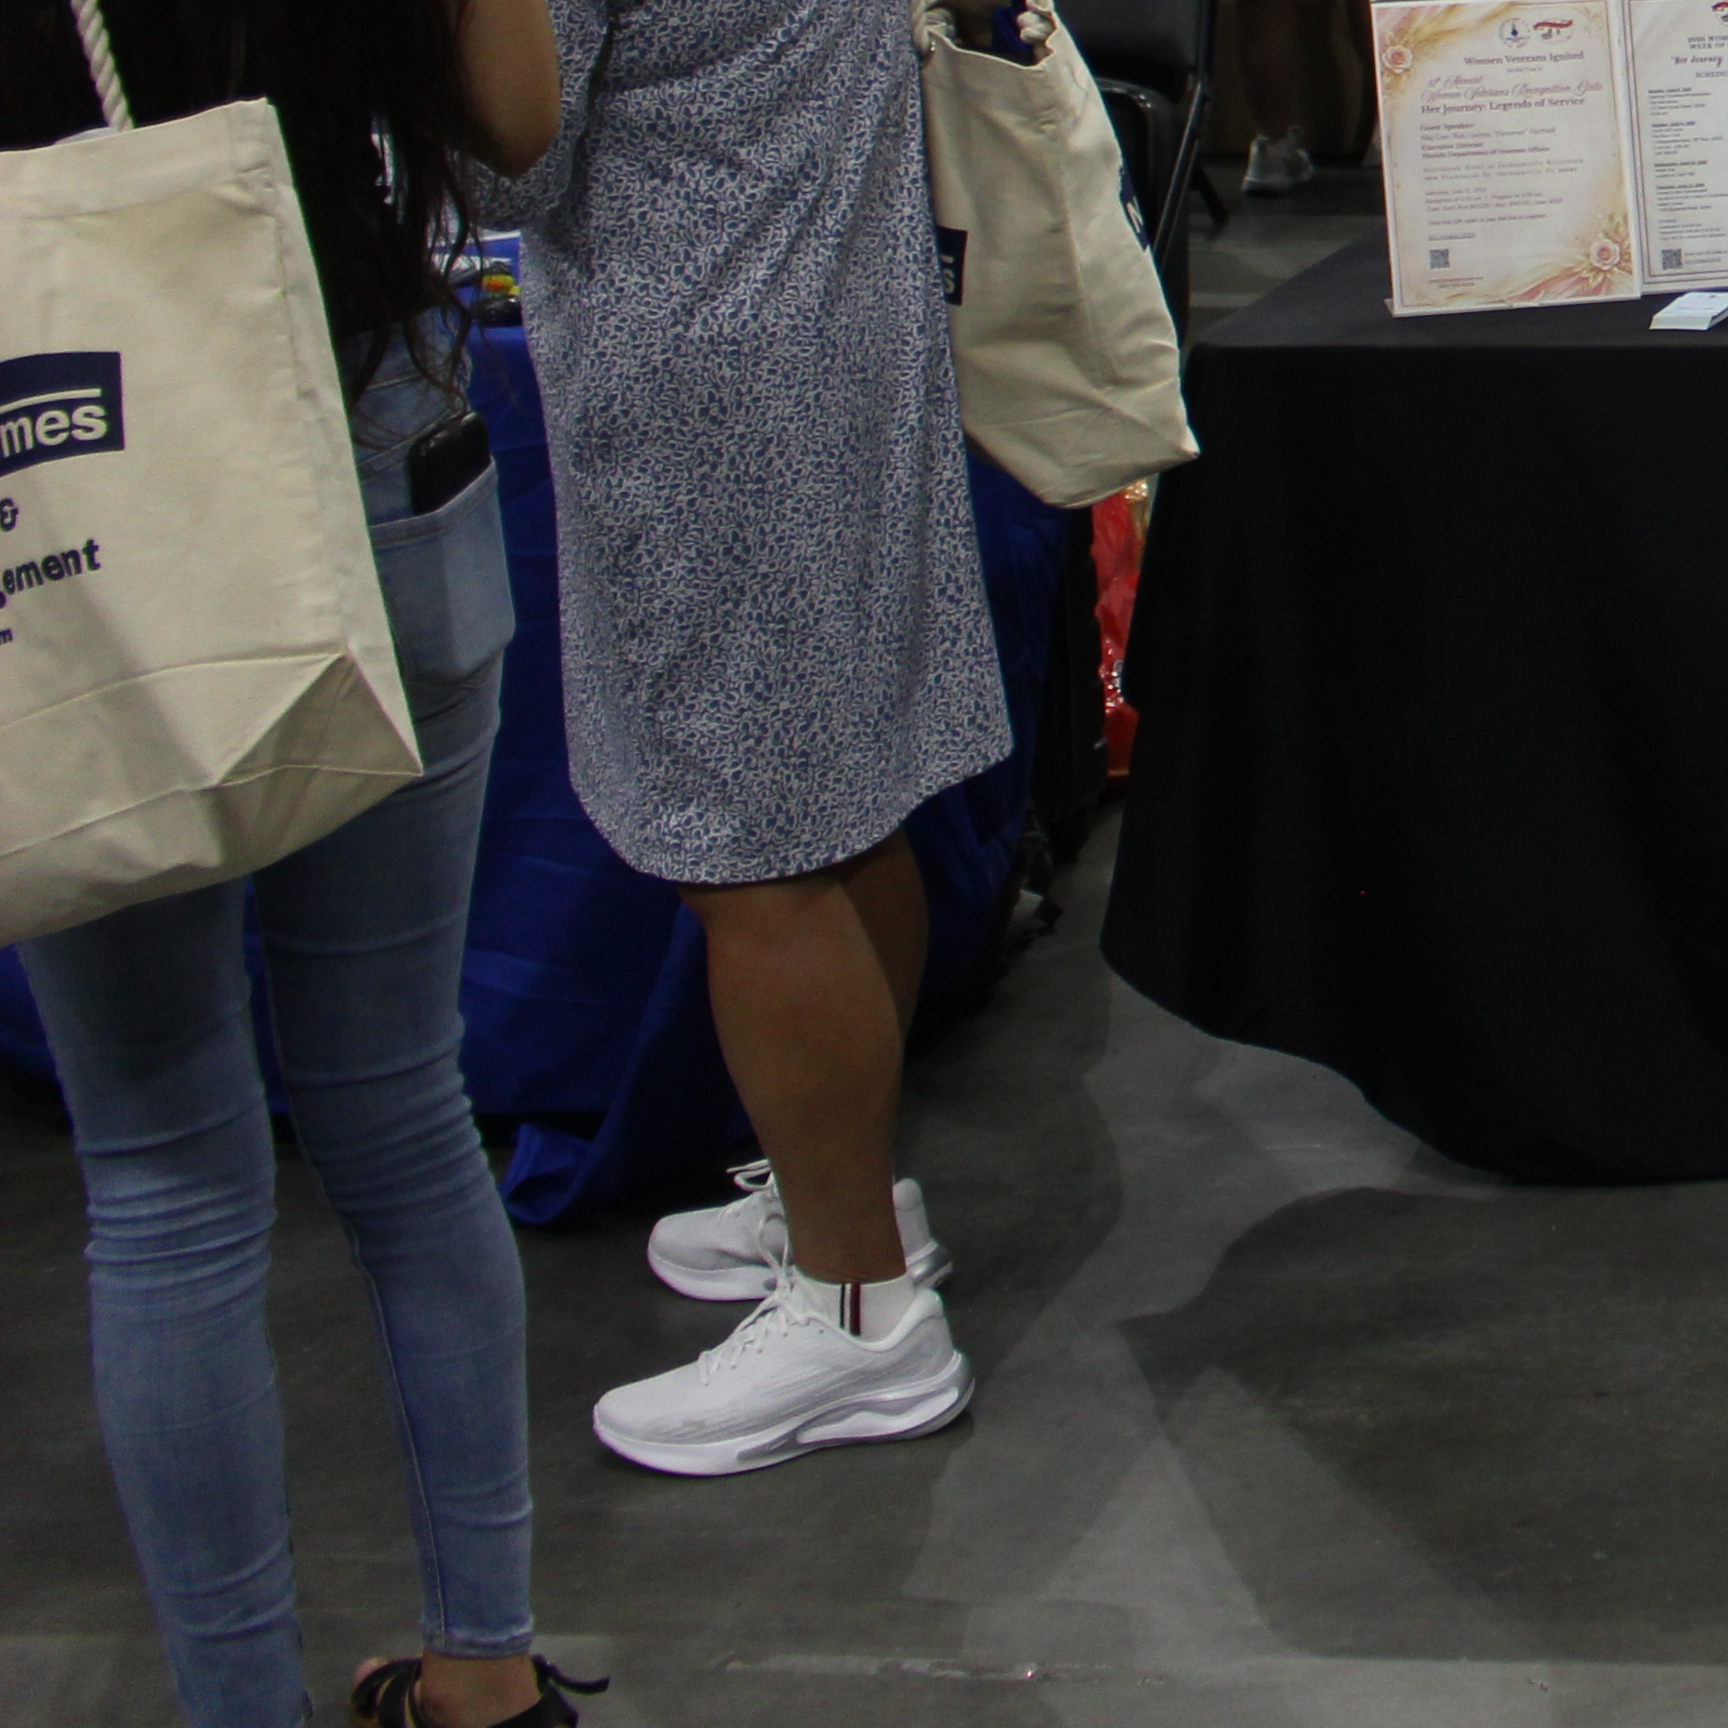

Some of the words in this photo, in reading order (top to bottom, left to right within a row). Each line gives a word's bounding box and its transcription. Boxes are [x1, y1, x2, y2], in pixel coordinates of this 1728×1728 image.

[1463, 56, 1503, 67] Women
[1549, 50, 1584, 65] Ignited
[1547, 97, 1586, 108] Service
[0, 538, 102, 610] ement
